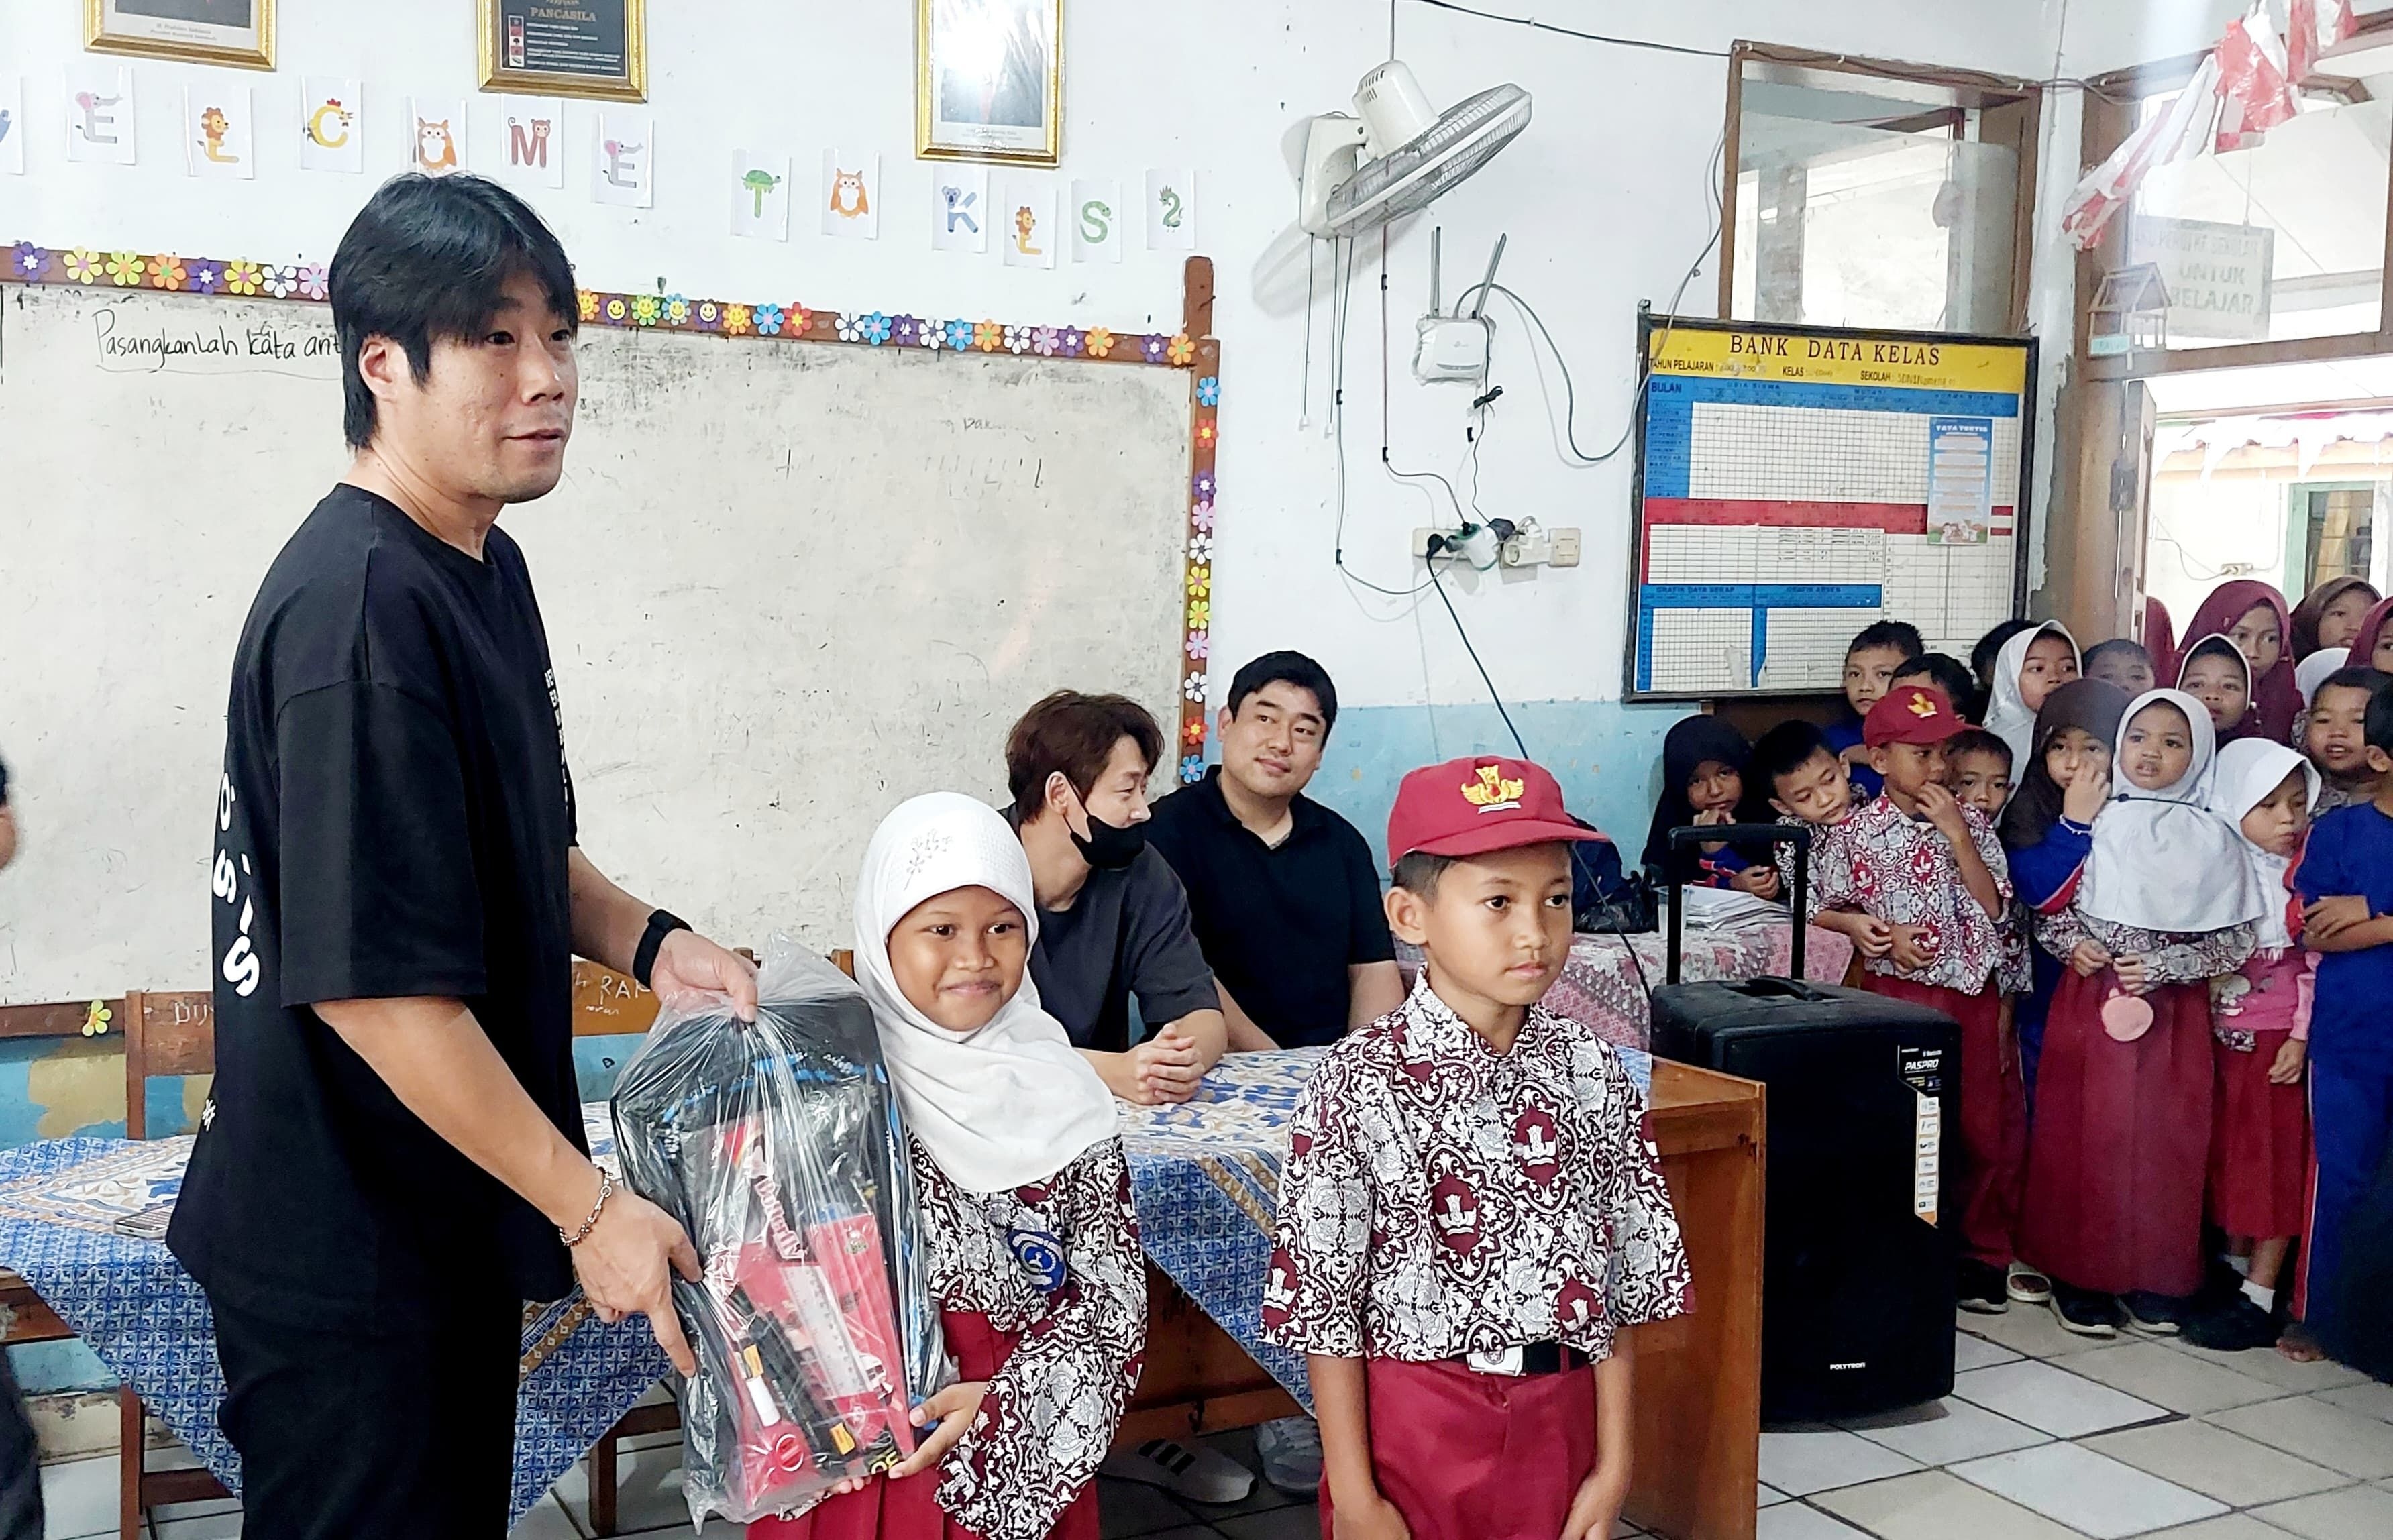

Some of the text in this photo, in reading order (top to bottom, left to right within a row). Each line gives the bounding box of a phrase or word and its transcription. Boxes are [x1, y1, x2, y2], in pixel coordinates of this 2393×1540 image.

[530, 7, 596, 22] PANCASILA
[2170, 286, 2254, 315] BELAJAR
[1730, 335, 1939, 365] BANK DATA KELAS
[1649, 358, 1673, 370] TAHUN
[1674, 360, 1713, 372] PELAJARAN
[1783, 366, 1804, 376] KELAS
[1860, 370, 1891, 381] SEKOLAH
[1652, 382, 1682, 393] BULAN
[1905, 1058, 1939, 1071] PASPRO
[1829, 1362, 1866, 1370] POLYTRON
